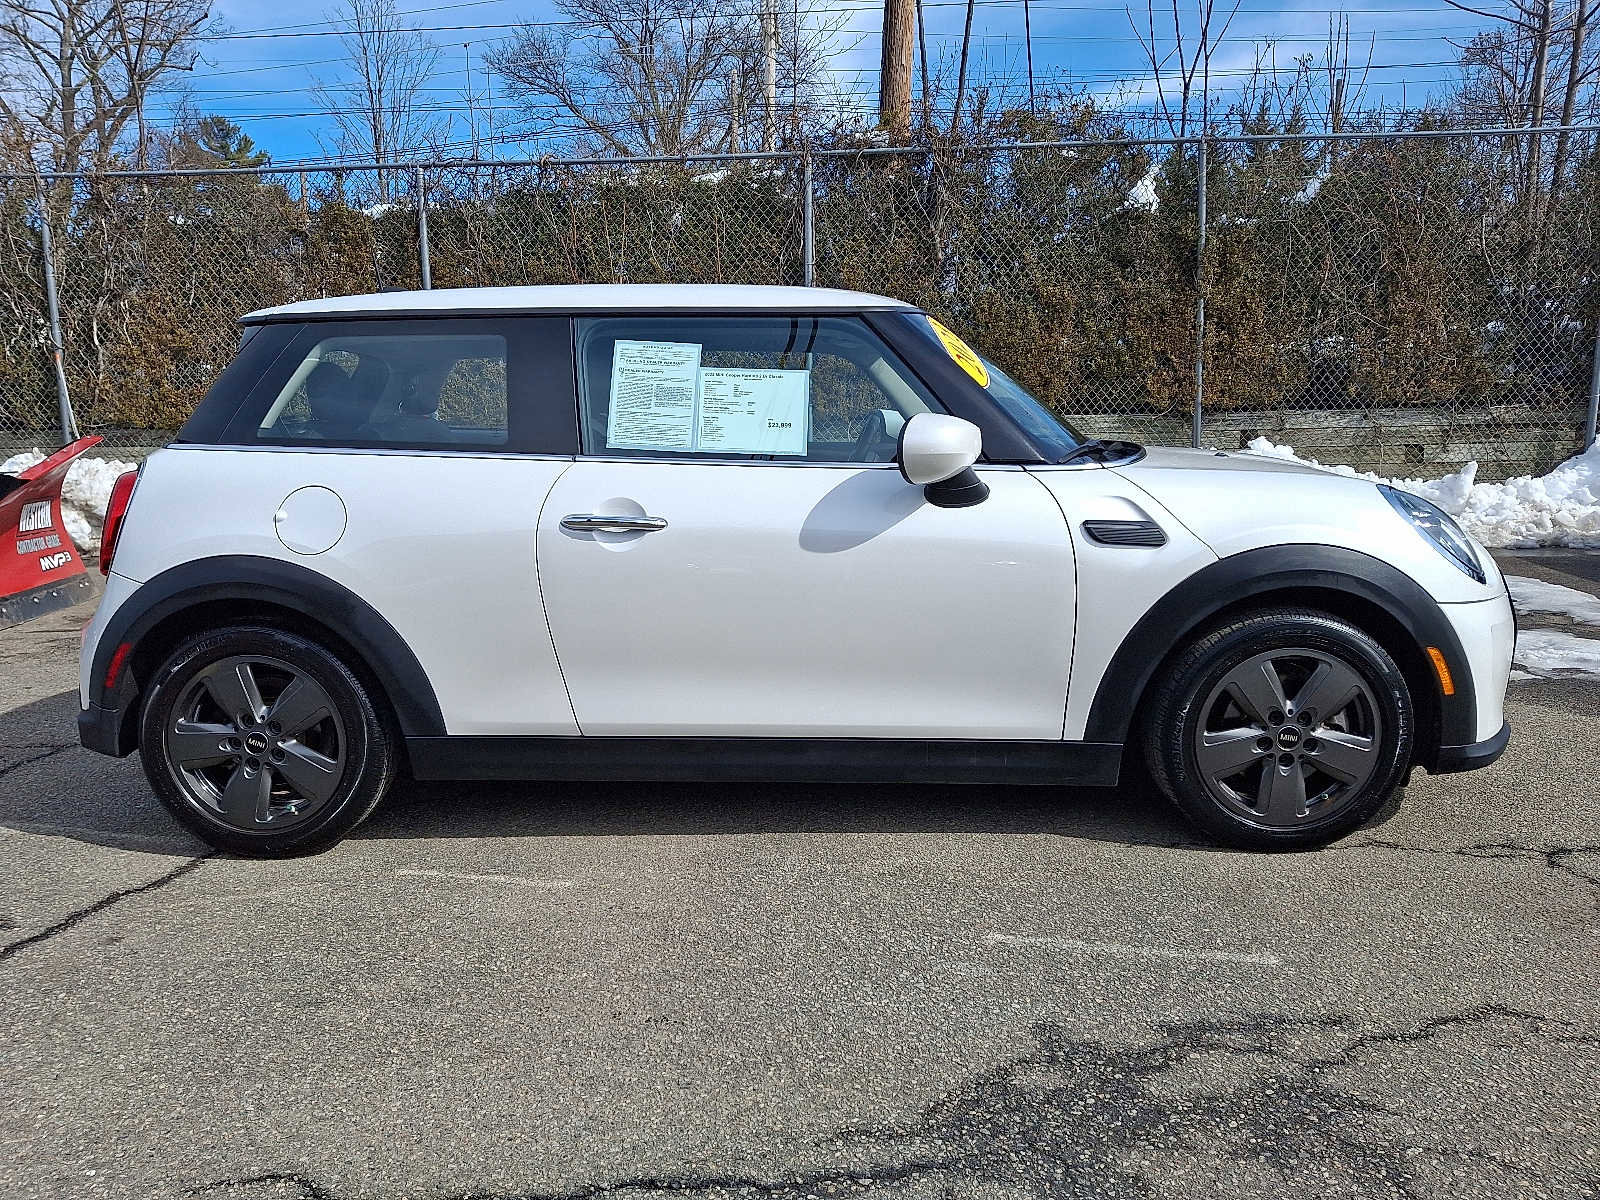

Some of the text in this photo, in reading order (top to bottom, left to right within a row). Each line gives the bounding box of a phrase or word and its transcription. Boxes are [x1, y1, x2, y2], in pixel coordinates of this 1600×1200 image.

[20, 500, 52, 532] WESTERN
[248, 738, 266, 748] MINI
[1280, 734, 1298, 742] MINI
